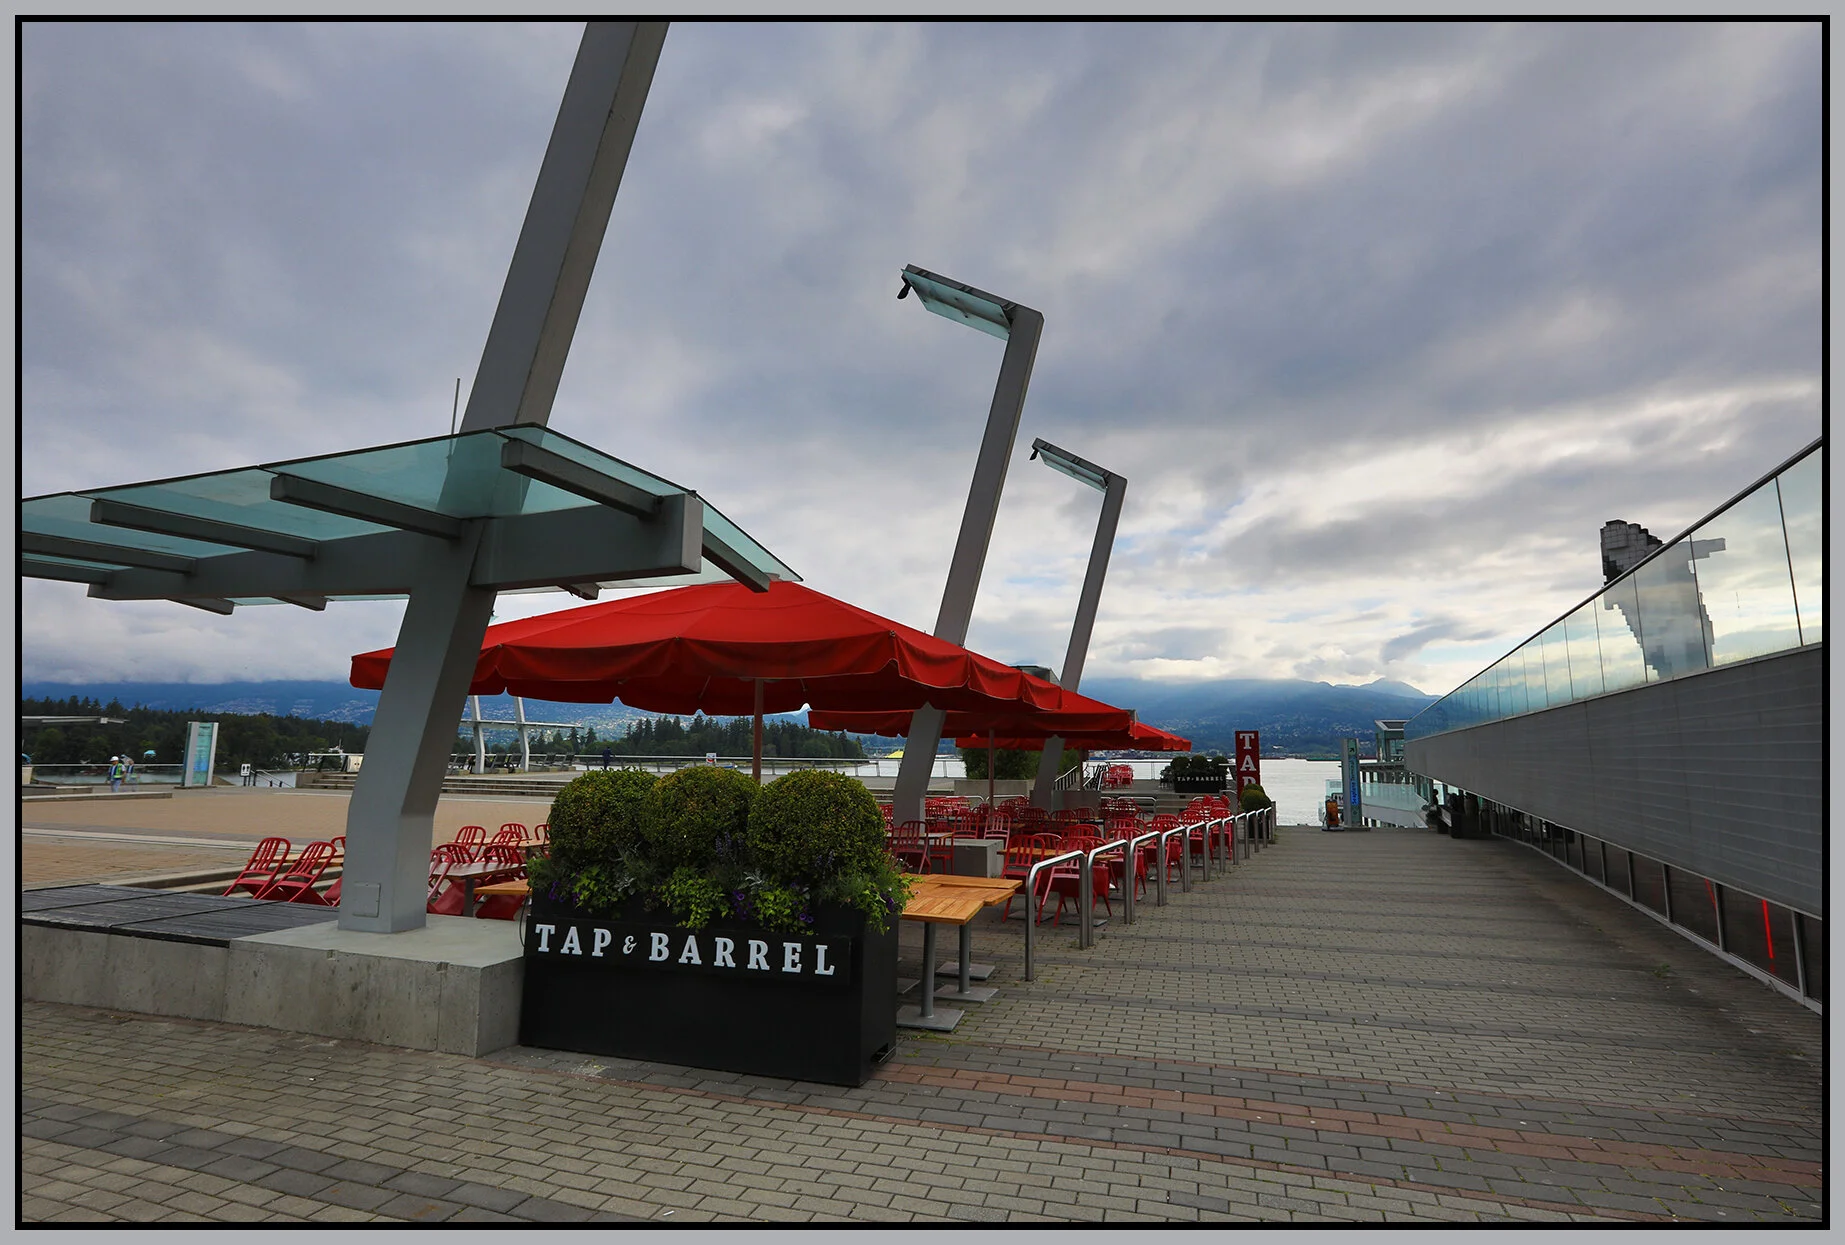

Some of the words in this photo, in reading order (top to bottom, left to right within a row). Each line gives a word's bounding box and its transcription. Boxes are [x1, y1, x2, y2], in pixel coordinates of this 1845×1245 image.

[535, 923, 612, 957] TAP
[622, 935, 638, 955] &
[649, 932, 835, 976] BARREL
